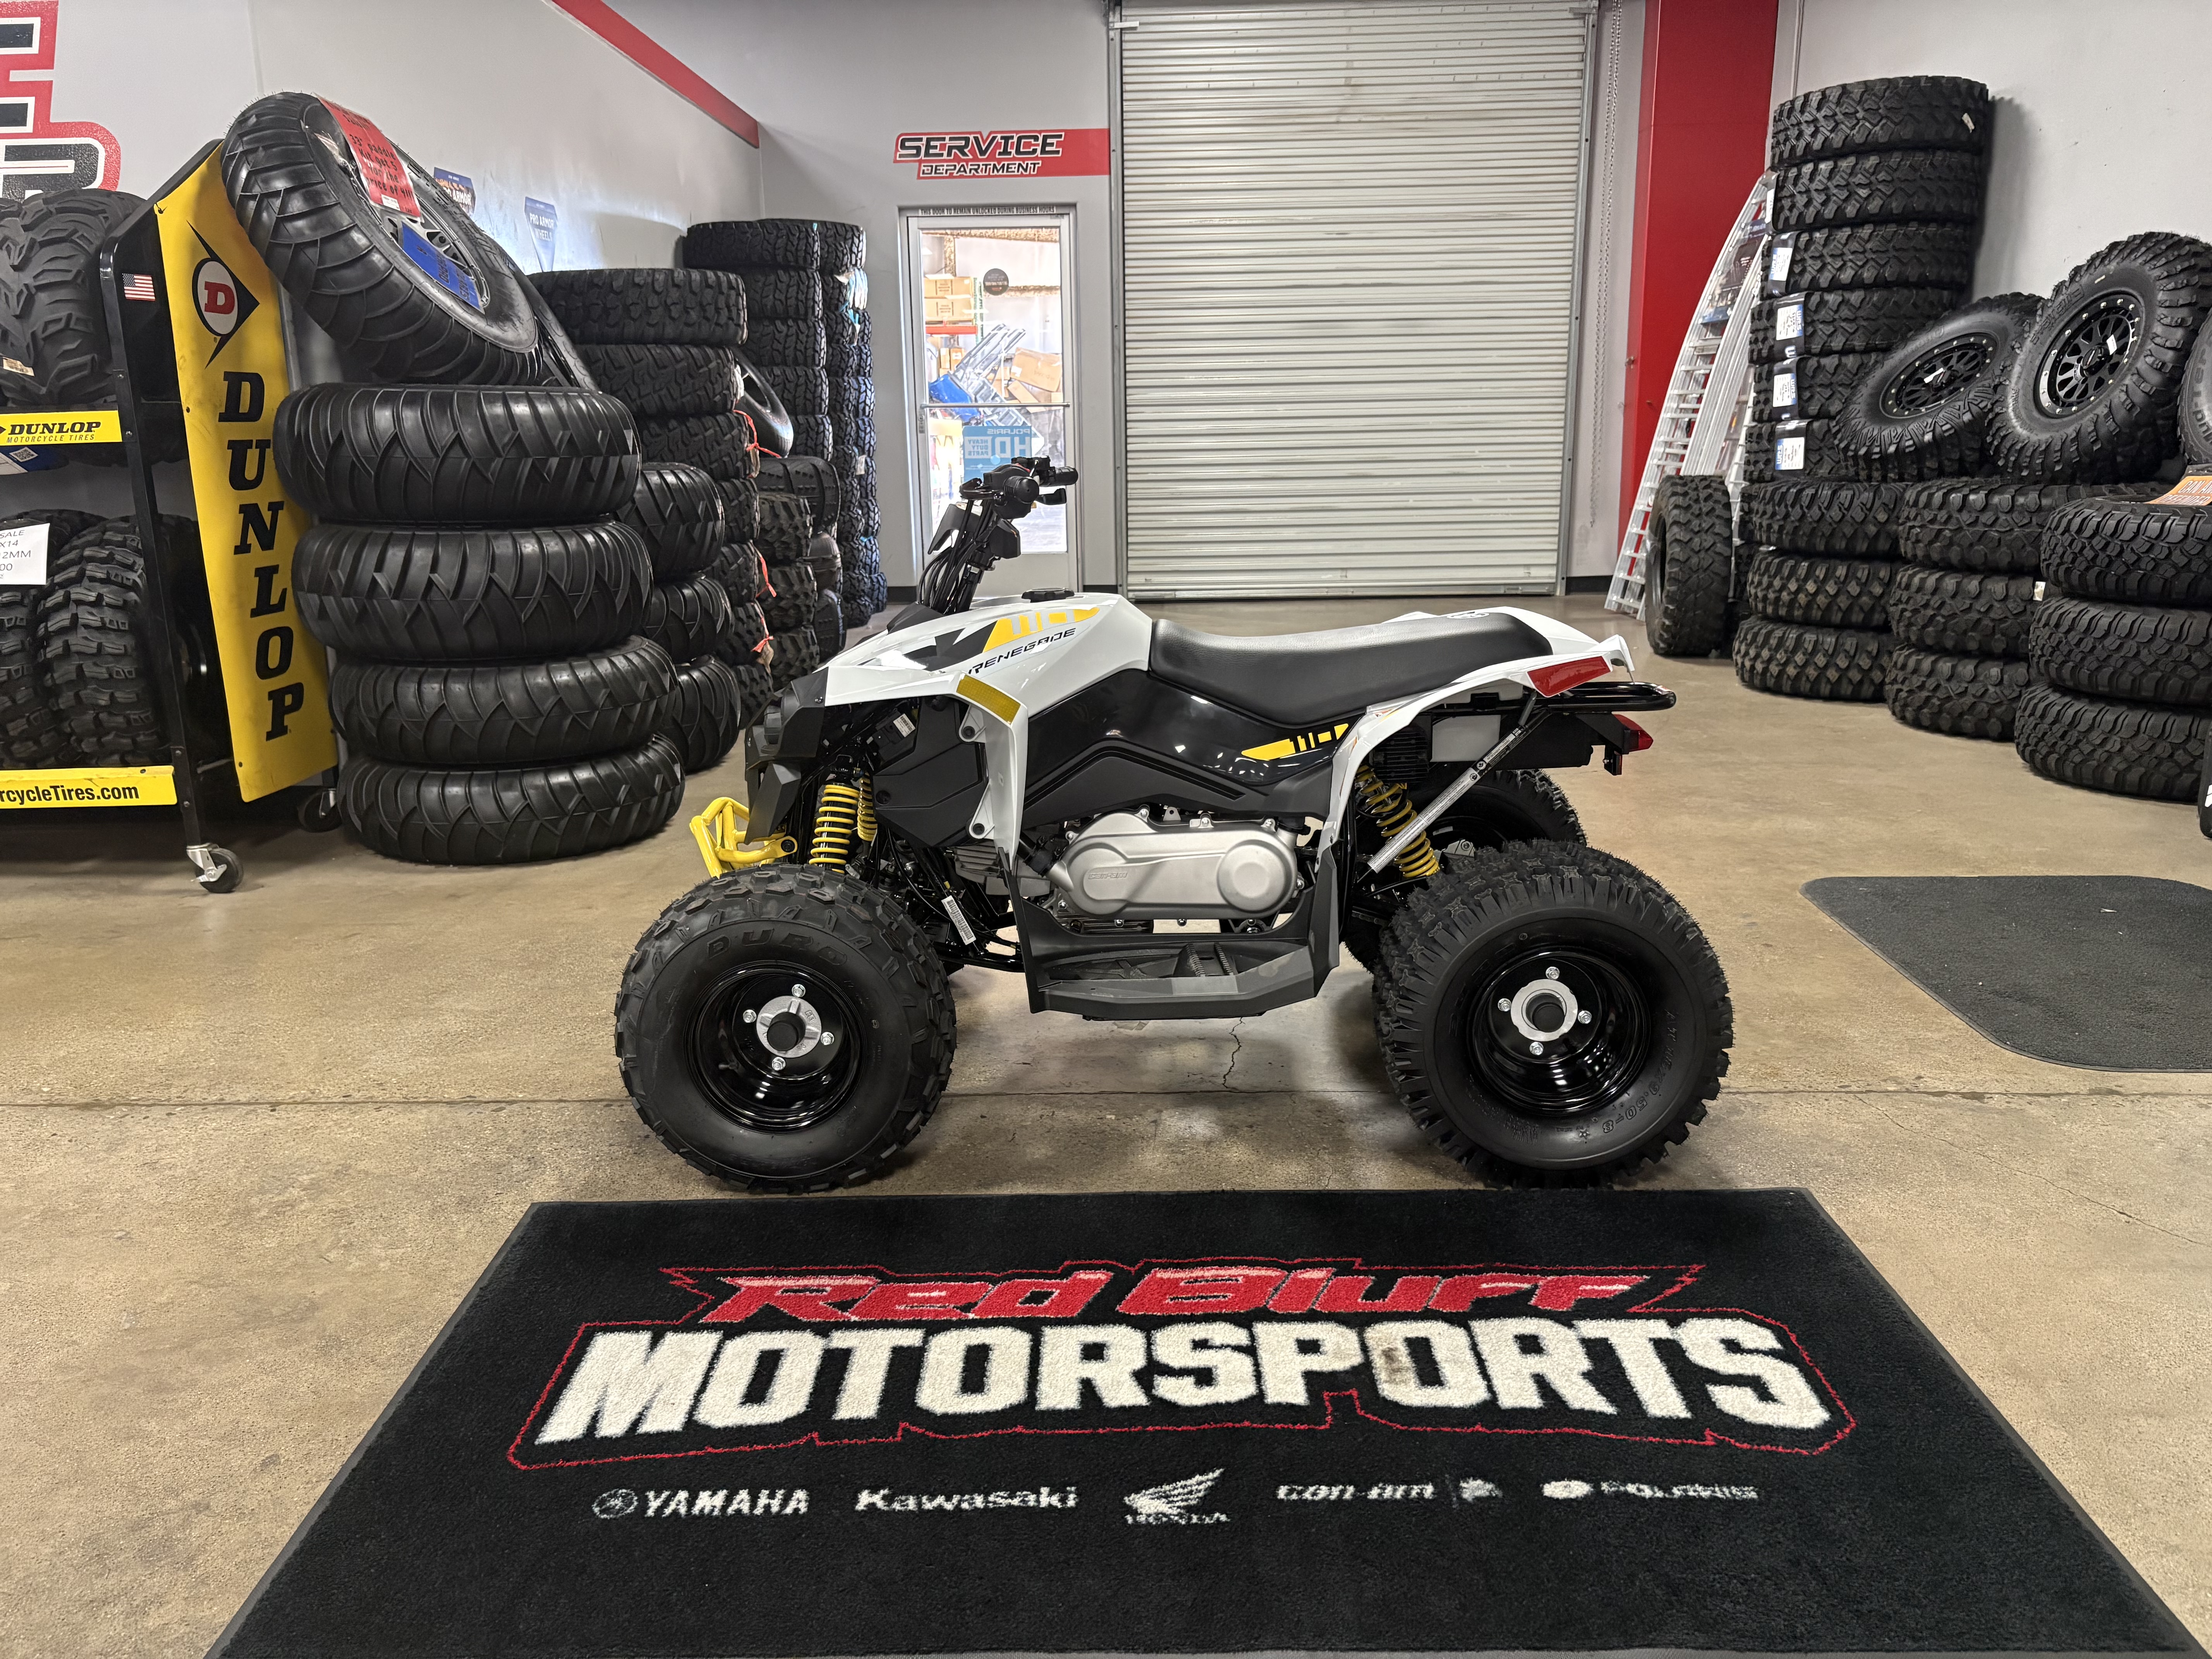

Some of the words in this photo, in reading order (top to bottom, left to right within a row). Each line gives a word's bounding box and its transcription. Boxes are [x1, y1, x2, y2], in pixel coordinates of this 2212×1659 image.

[897, 133, 1064, 160] SERVICE
[921, 161, 1041, 176] DEPARTMENT
[453, 190, 471, 206] ARMOR
[530, 213, 539, 225] PRO
[539, 215, 554, 228] ARMOR
[8, 422, 101, 435] DUNLOP
[7, 435, 64, 443] MOTORCYCLE
[2178, 480, 2205, 493] CAN
[2159, 494, 2211, 506] DEFENDER
[0, 530, 25, 539] SALE
[218, 371, 304, 741] DUNLOP
[969, 628, 1076, 675] RENEGADE
[0, 785, 139, 805] rcycleTires.com
[707, 928, 847, 965] DURO
[698, 1270, 1114, 1323] Red
[533, 1317, 1831, 1445] MOTORSPORTS
[644, 1489, 810, 1517] YAMAHA
[854, 1486, 1078, 1512] Kawasaki
